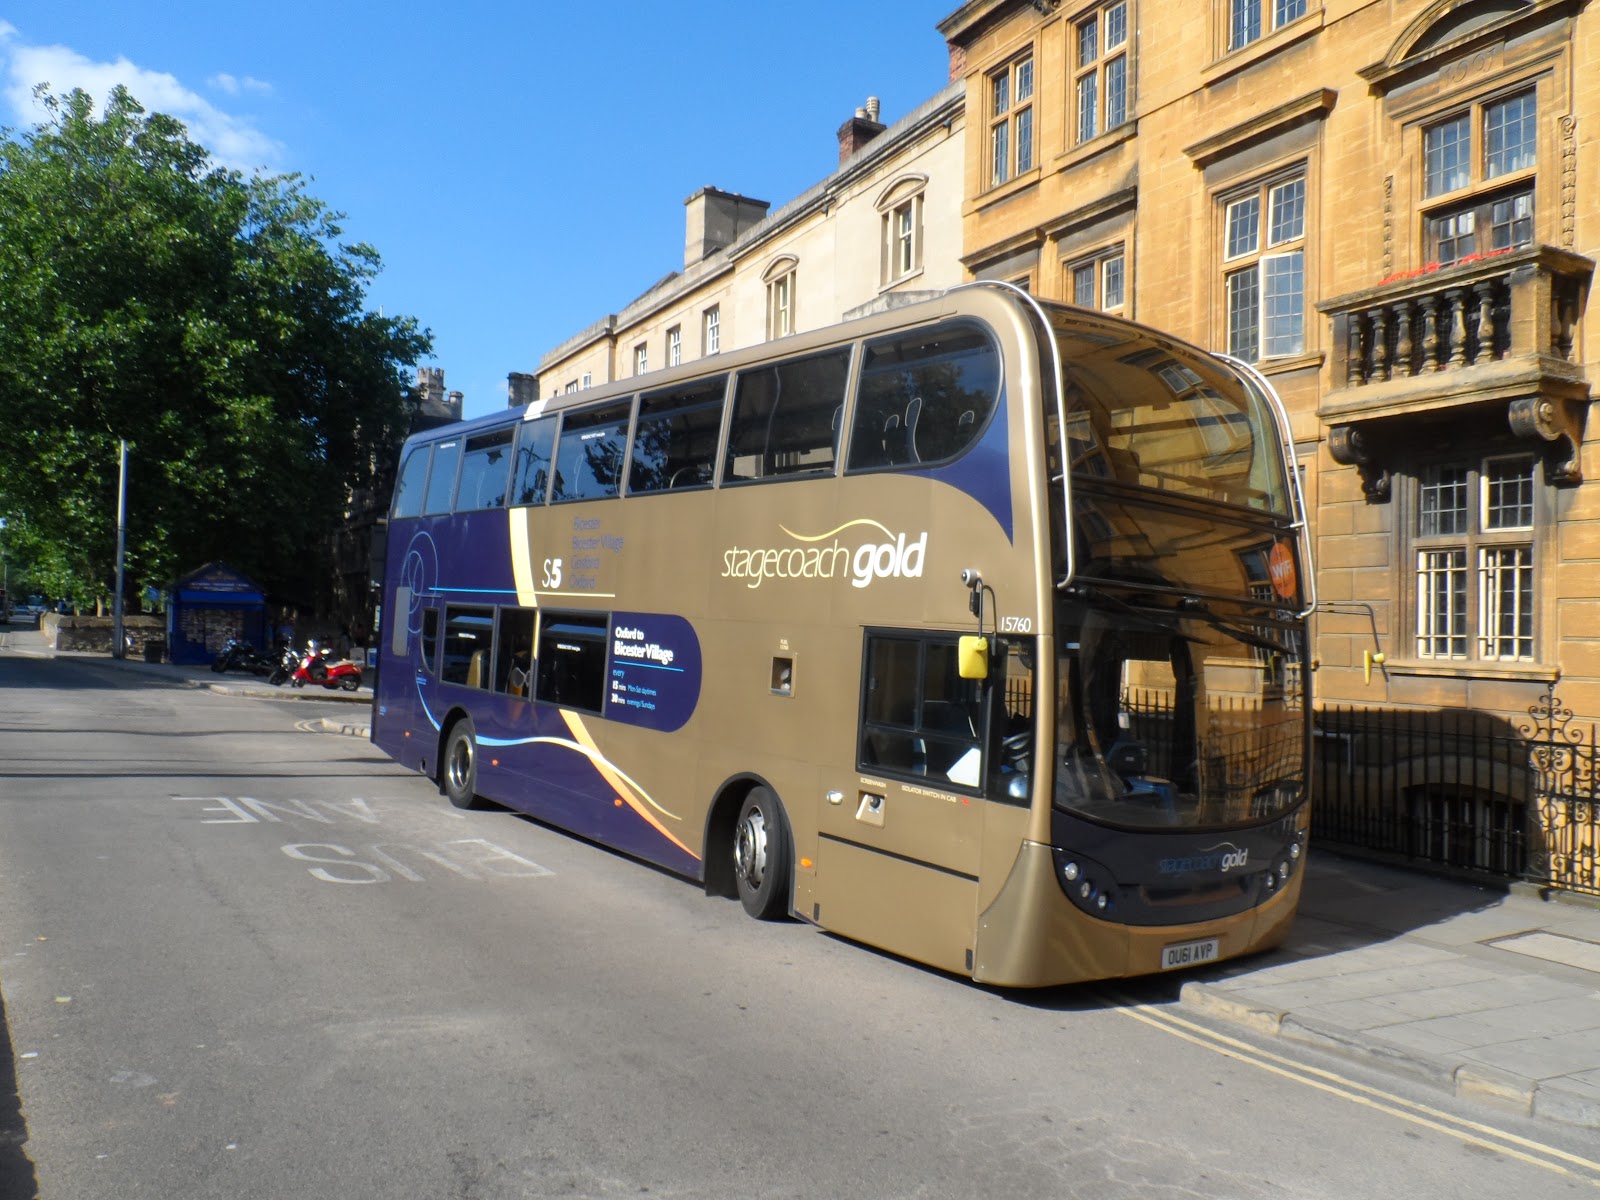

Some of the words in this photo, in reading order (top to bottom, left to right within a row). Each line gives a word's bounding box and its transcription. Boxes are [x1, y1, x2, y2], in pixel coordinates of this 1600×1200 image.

[721, 538, 850, 589] stagecoach
[851, 531, 928, 588] gold
[541, 558, 562, 589] S5
[615, 626, 637, 640] Oxford
[637, 630, 644, 640] to
[1001, 616, 1031, 633] 15760
[614, 640, 645, 658] Bicester
[645, 643, 674, 665] Village
[613, 669, 625, 678] every
[612, 680, 619, 690] 15
[901, 784, 922, 795] ISOLATOR
[922, 789, 940, 799] SWITCH
[940, 793, 946, 801] IN
[946, 795, 957, 803] CAB
[279, 837, 557, 885] BUS
[1221, 848, 1249, 873] gold
[1193, 943, 1213, 961] AVP
